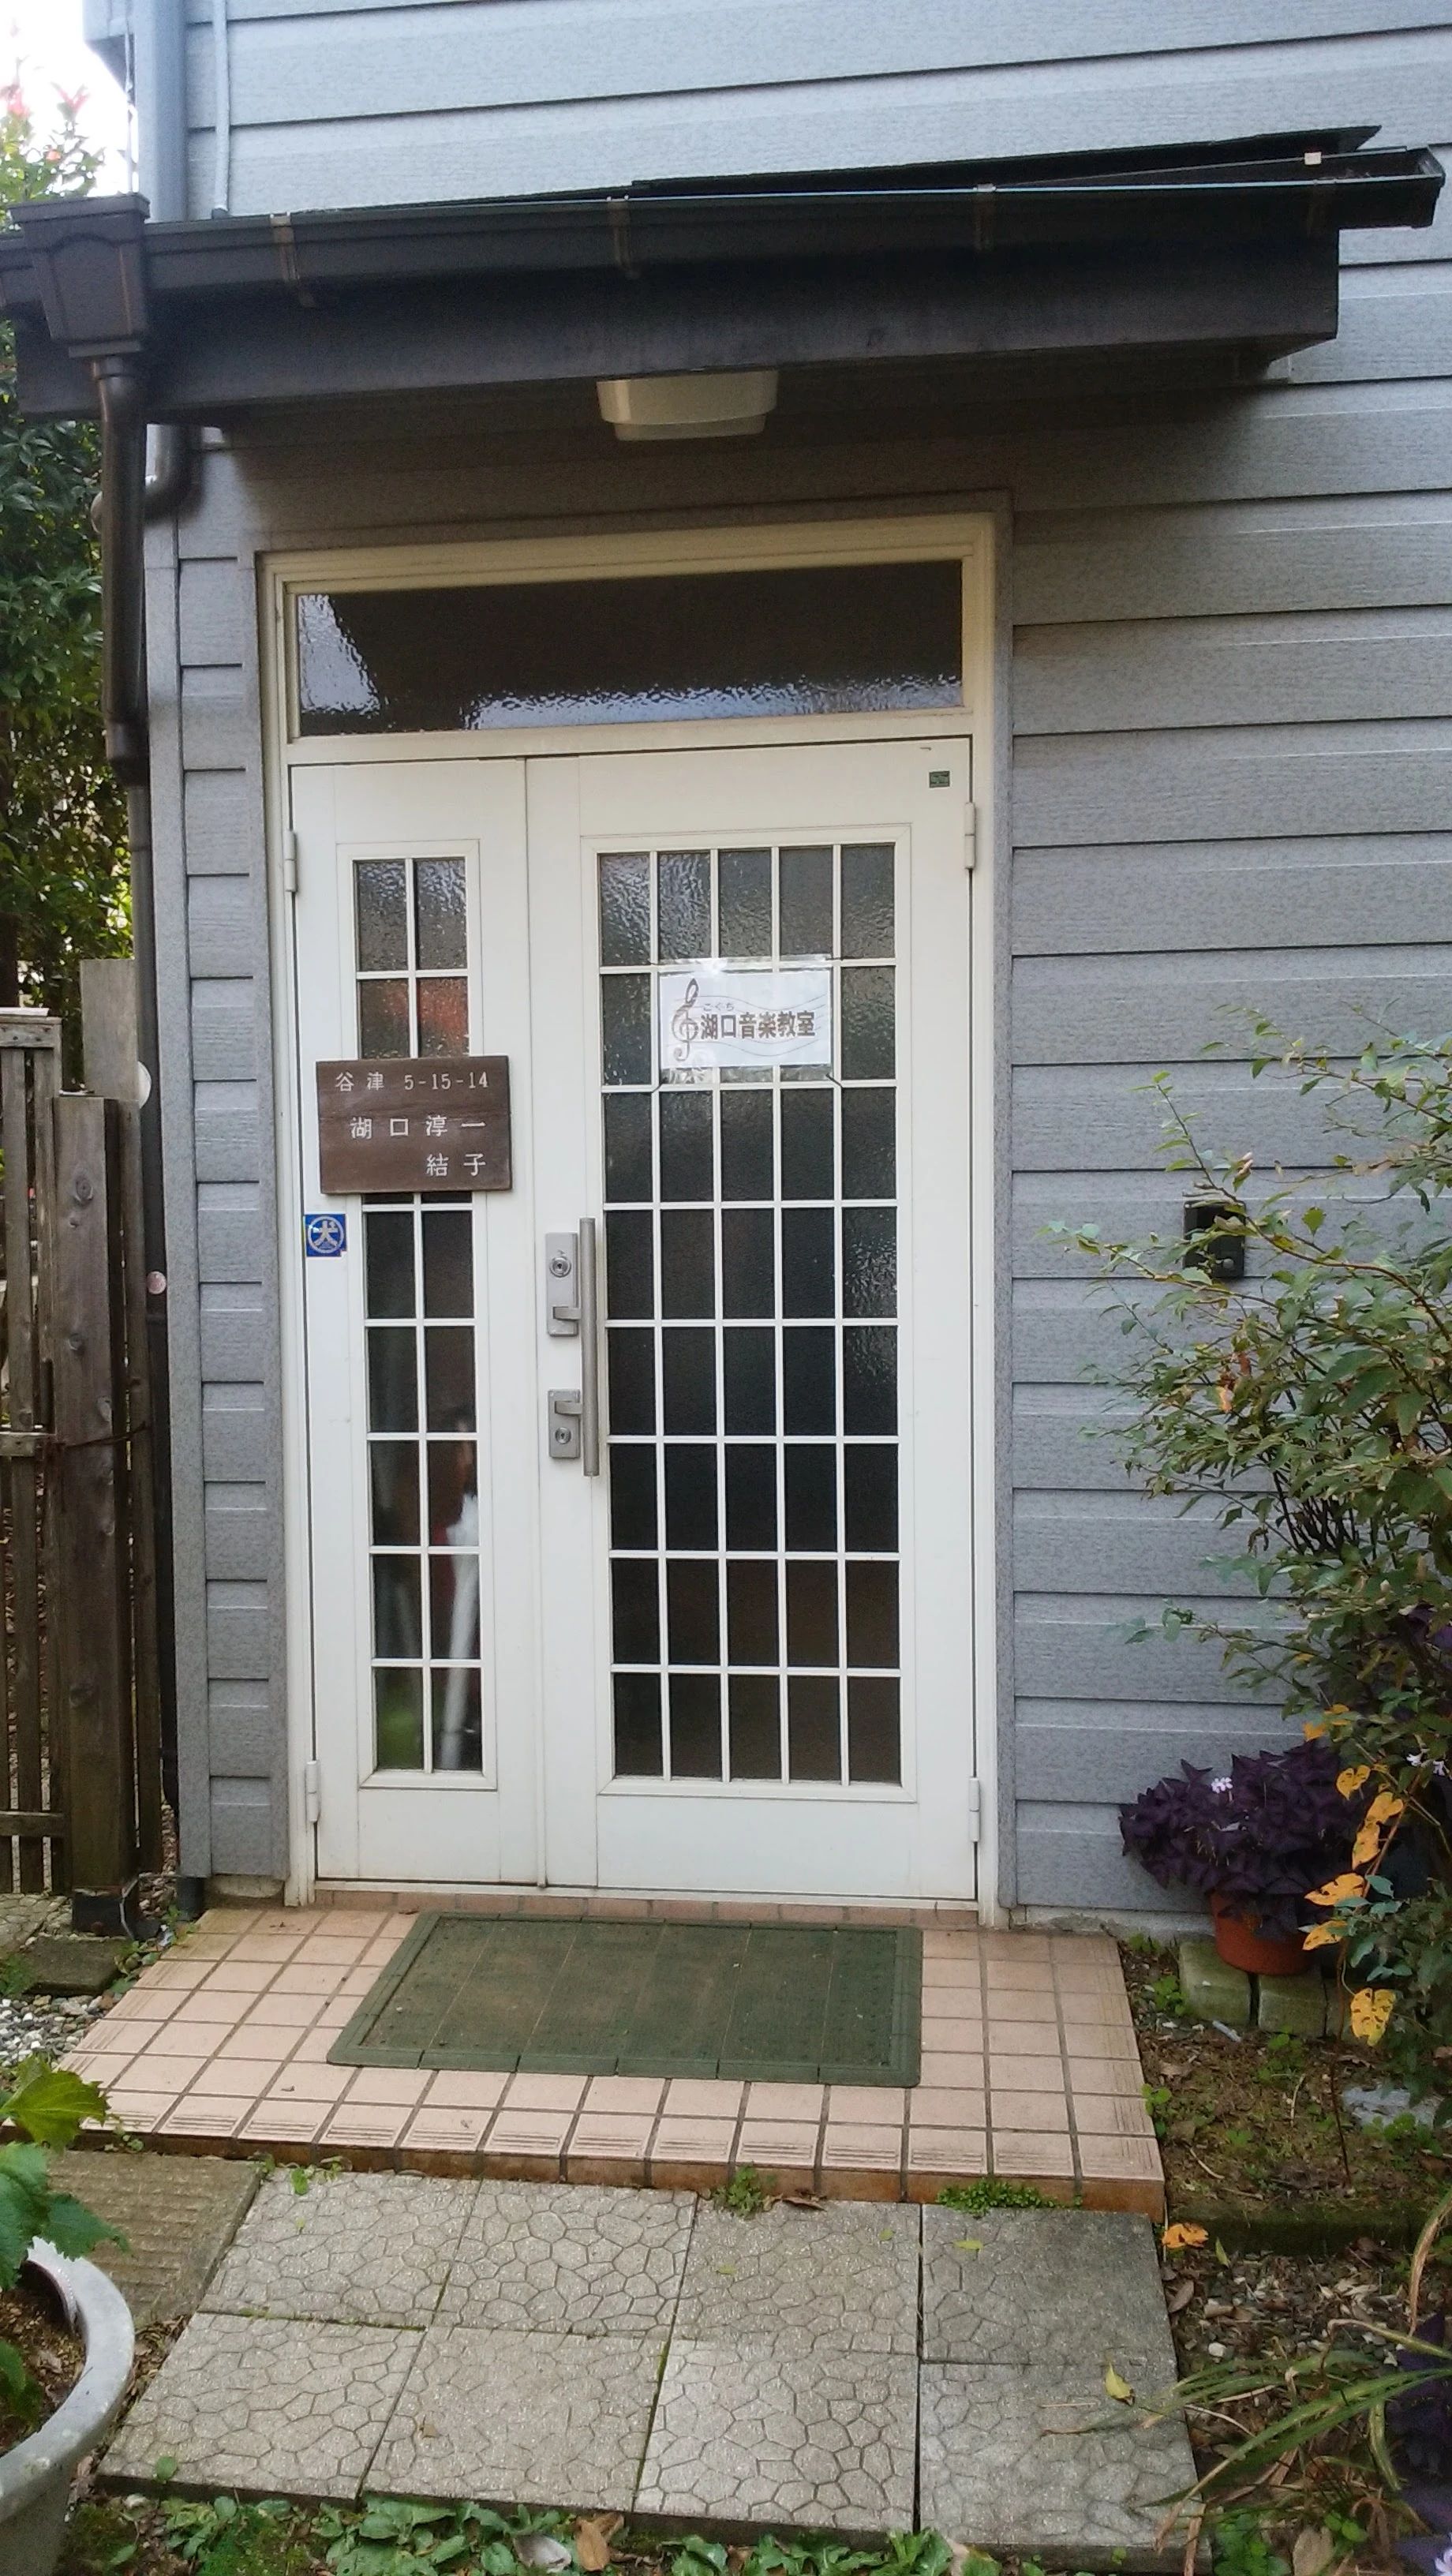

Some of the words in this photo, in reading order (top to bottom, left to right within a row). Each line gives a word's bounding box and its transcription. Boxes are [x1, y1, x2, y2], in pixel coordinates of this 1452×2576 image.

[701, 1010, 816, 1040] 湖口音楽教室
[335, 1071, 385, 1092] 谷津
[404, 1071, 489, 1091] 5-15-14
[350, 1114, 486, 1140] 湖口淳一
[425, 1152, 486, 1177] 結子
